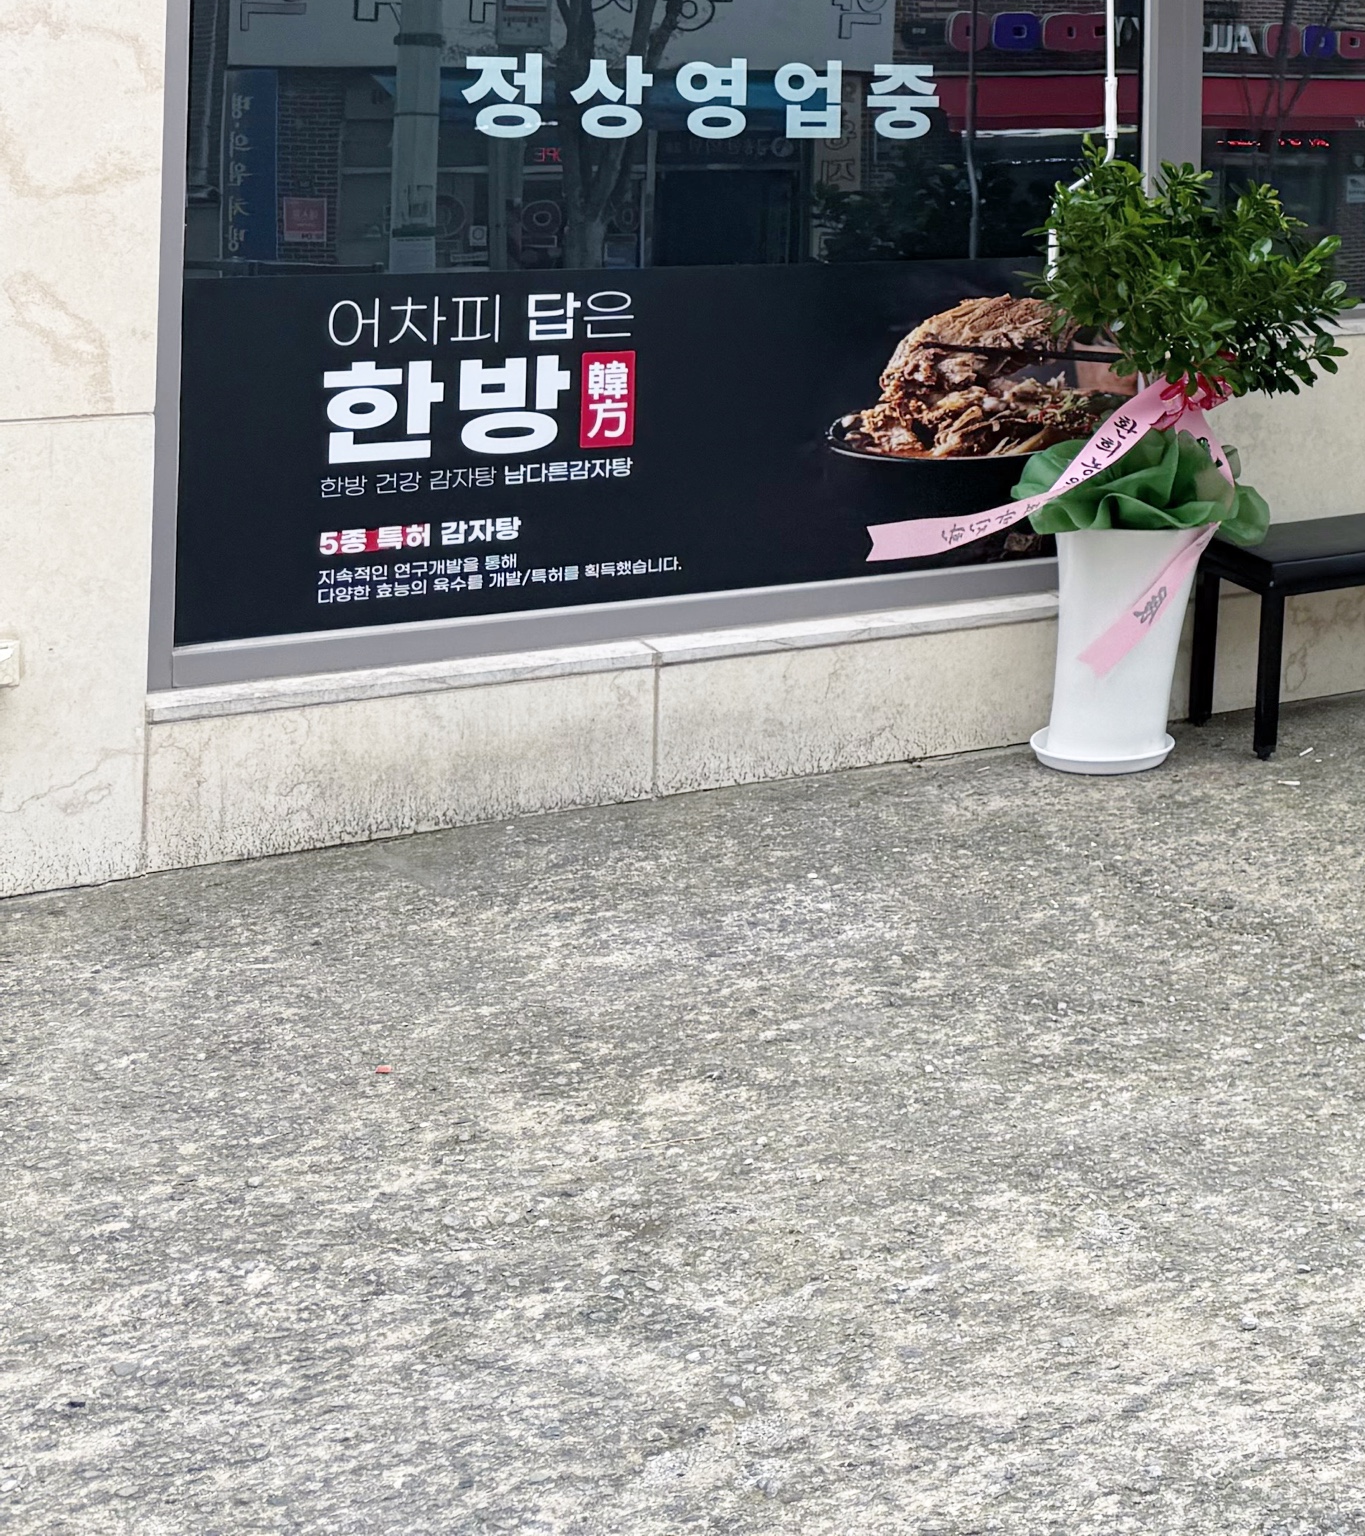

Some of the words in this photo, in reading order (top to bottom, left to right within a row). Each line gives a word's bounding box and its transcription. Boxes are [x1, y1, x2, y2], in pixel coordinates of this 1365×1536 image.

[462, 54, 940, 139] 정상영업중
[329, 294, 500, 349] 어차피
[526, 289, 635, 342] 답은
[322, 354, 571, 463] 한방
[584, 360, 629, 442] 韓方
[320, 474, 367, 498] 한방
[375, 471, 422, 495] 건강
[429, 466, 497, 491] 감자탕
[504, 457, 633, 486] 남다른감자탕
[319, 529, 367, 556] 5종
[376, 523, 431, 551] 특허
[440, 516, 522, 546] 감자탕
[317, 565, 389, 587] 지속적인
[394, 557, 479, 581] 연구개발을
[484, 553, 518, 571] 통해
[317, 584, 370, 605] 다양한
[375, 581, 428, 599] 효능의
[432, 573, 483, 594] 육수를
[489, 563, 580, 589] 개발/특허를
[584, 555, 683, 579] 획득했습니다.
